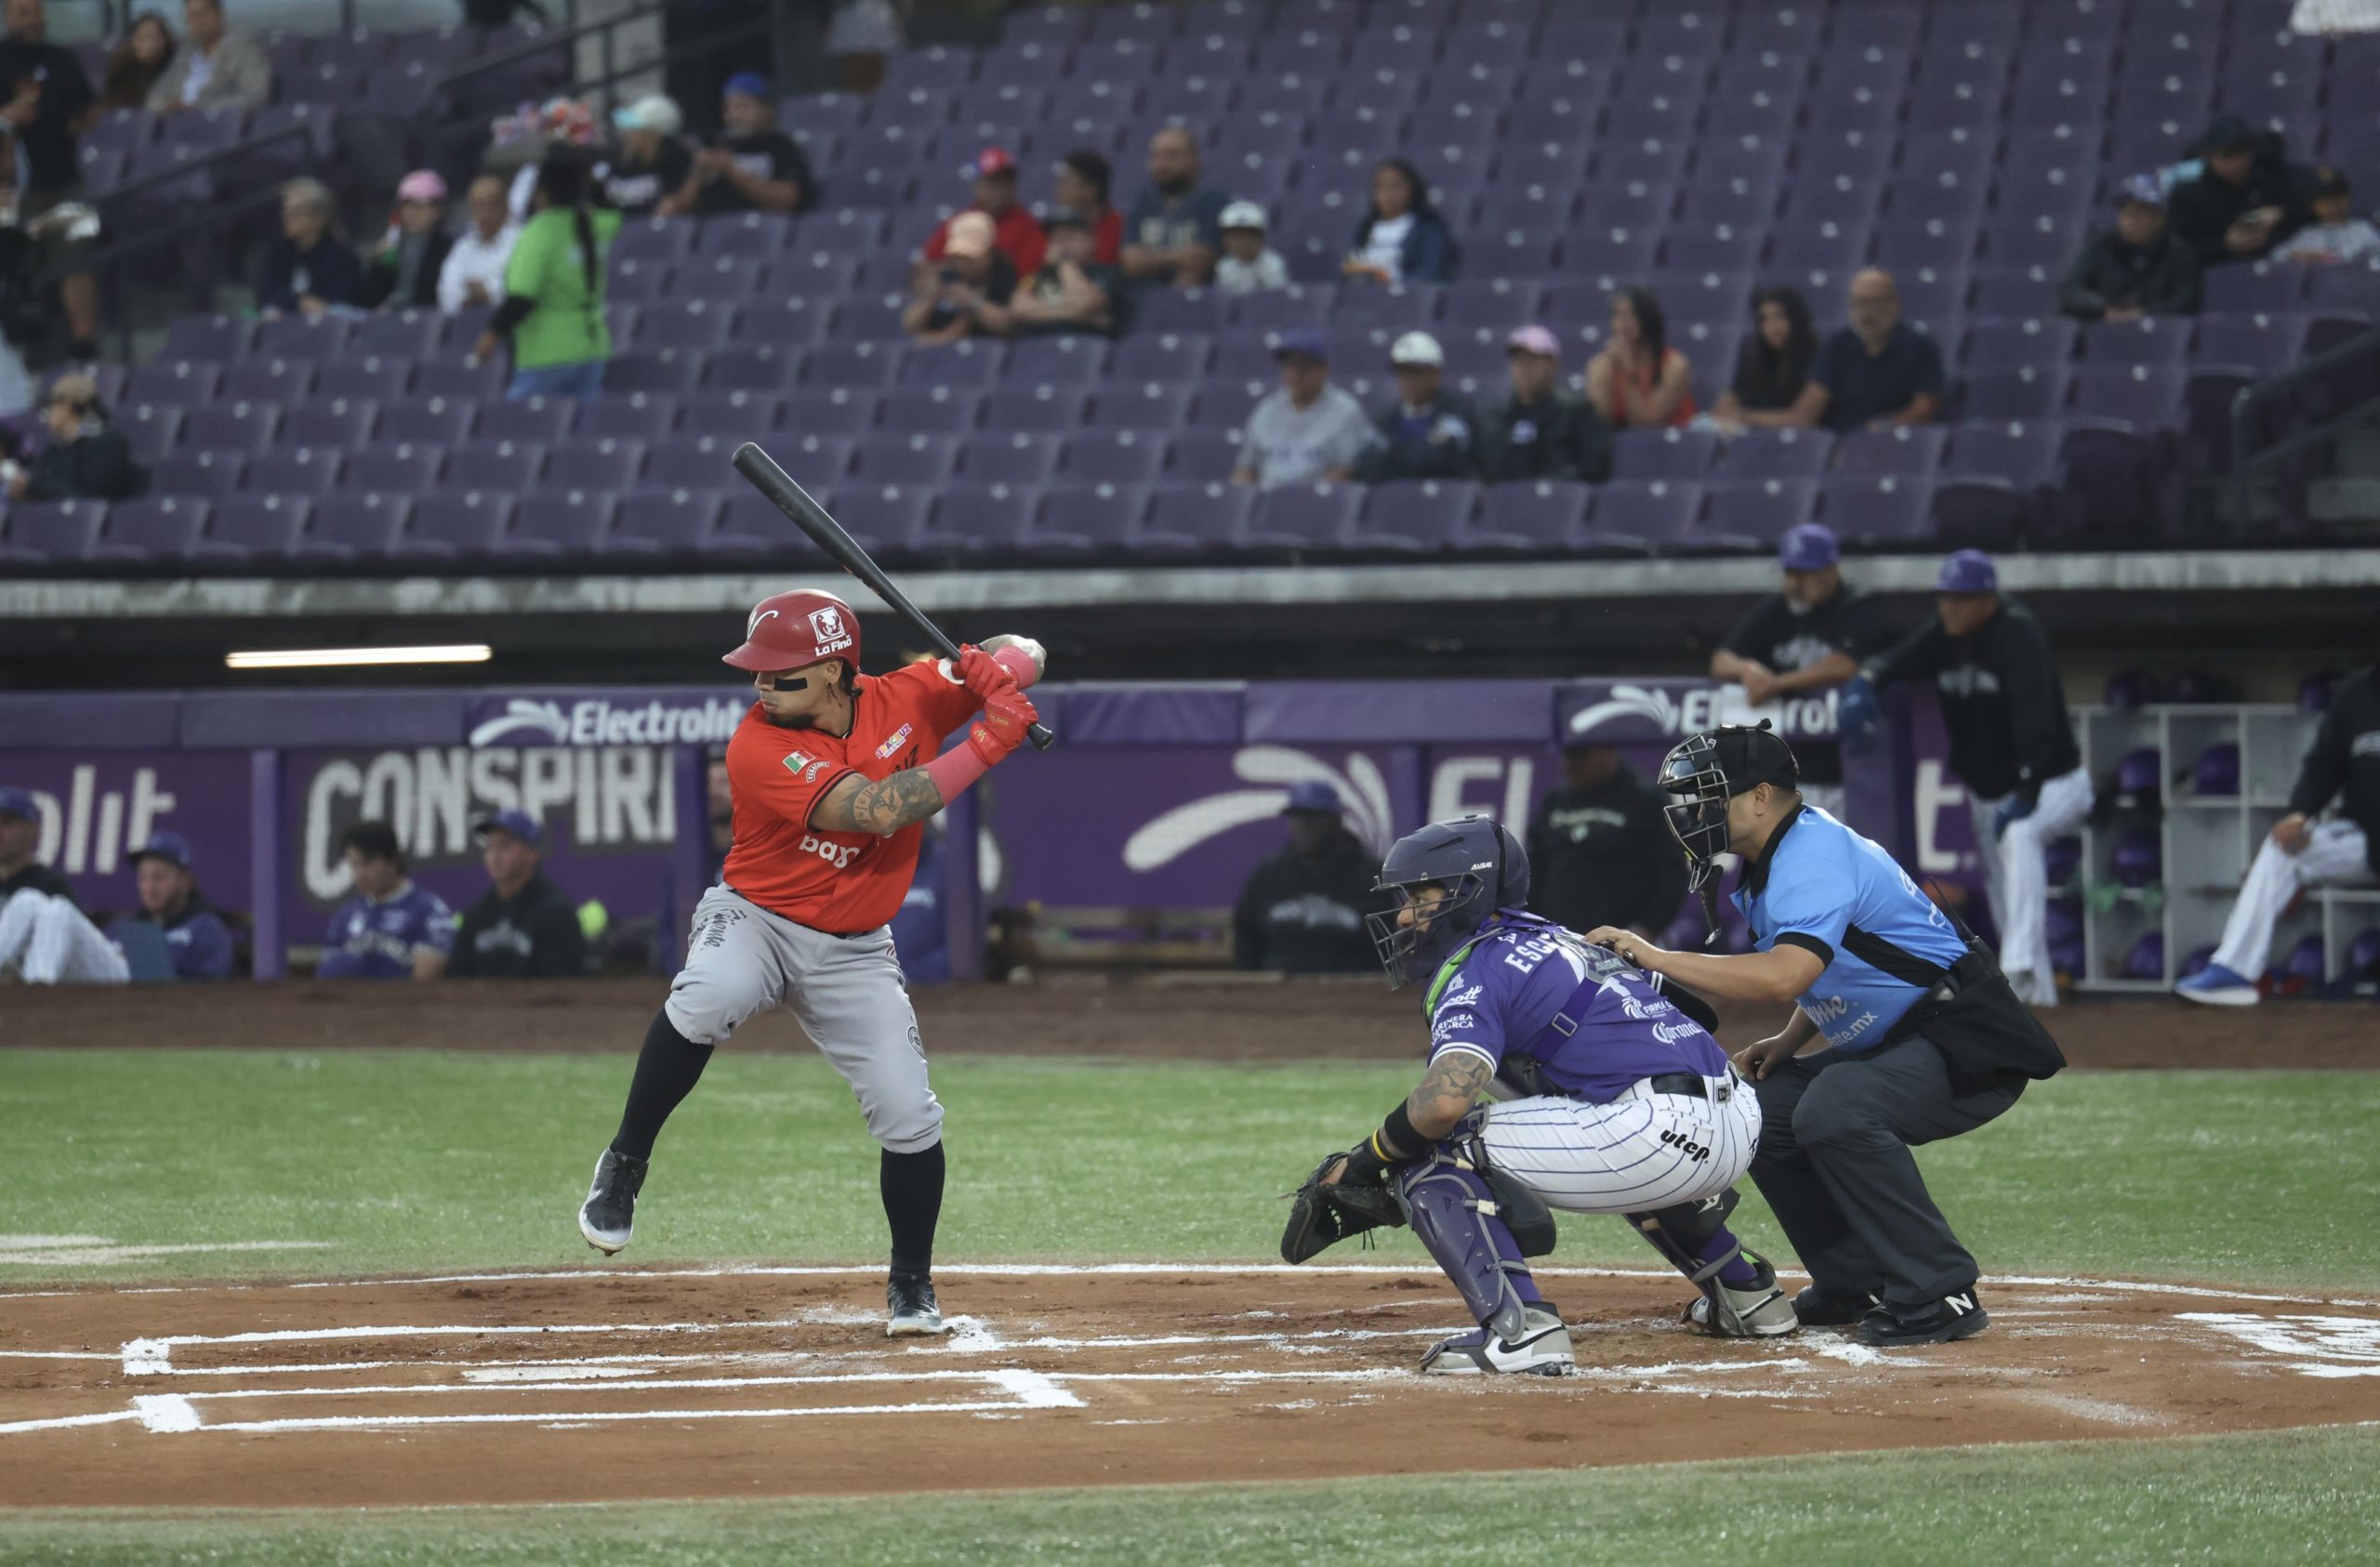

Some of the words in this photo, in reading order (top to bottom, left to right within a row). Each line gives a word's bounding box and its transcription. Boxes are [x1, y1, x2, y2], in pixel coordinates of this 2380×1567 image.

[815, 647, 830, 656] La
[1652, 1021, 1703, 1046] Corona
[1944, 1293, 1974, 1316] N
